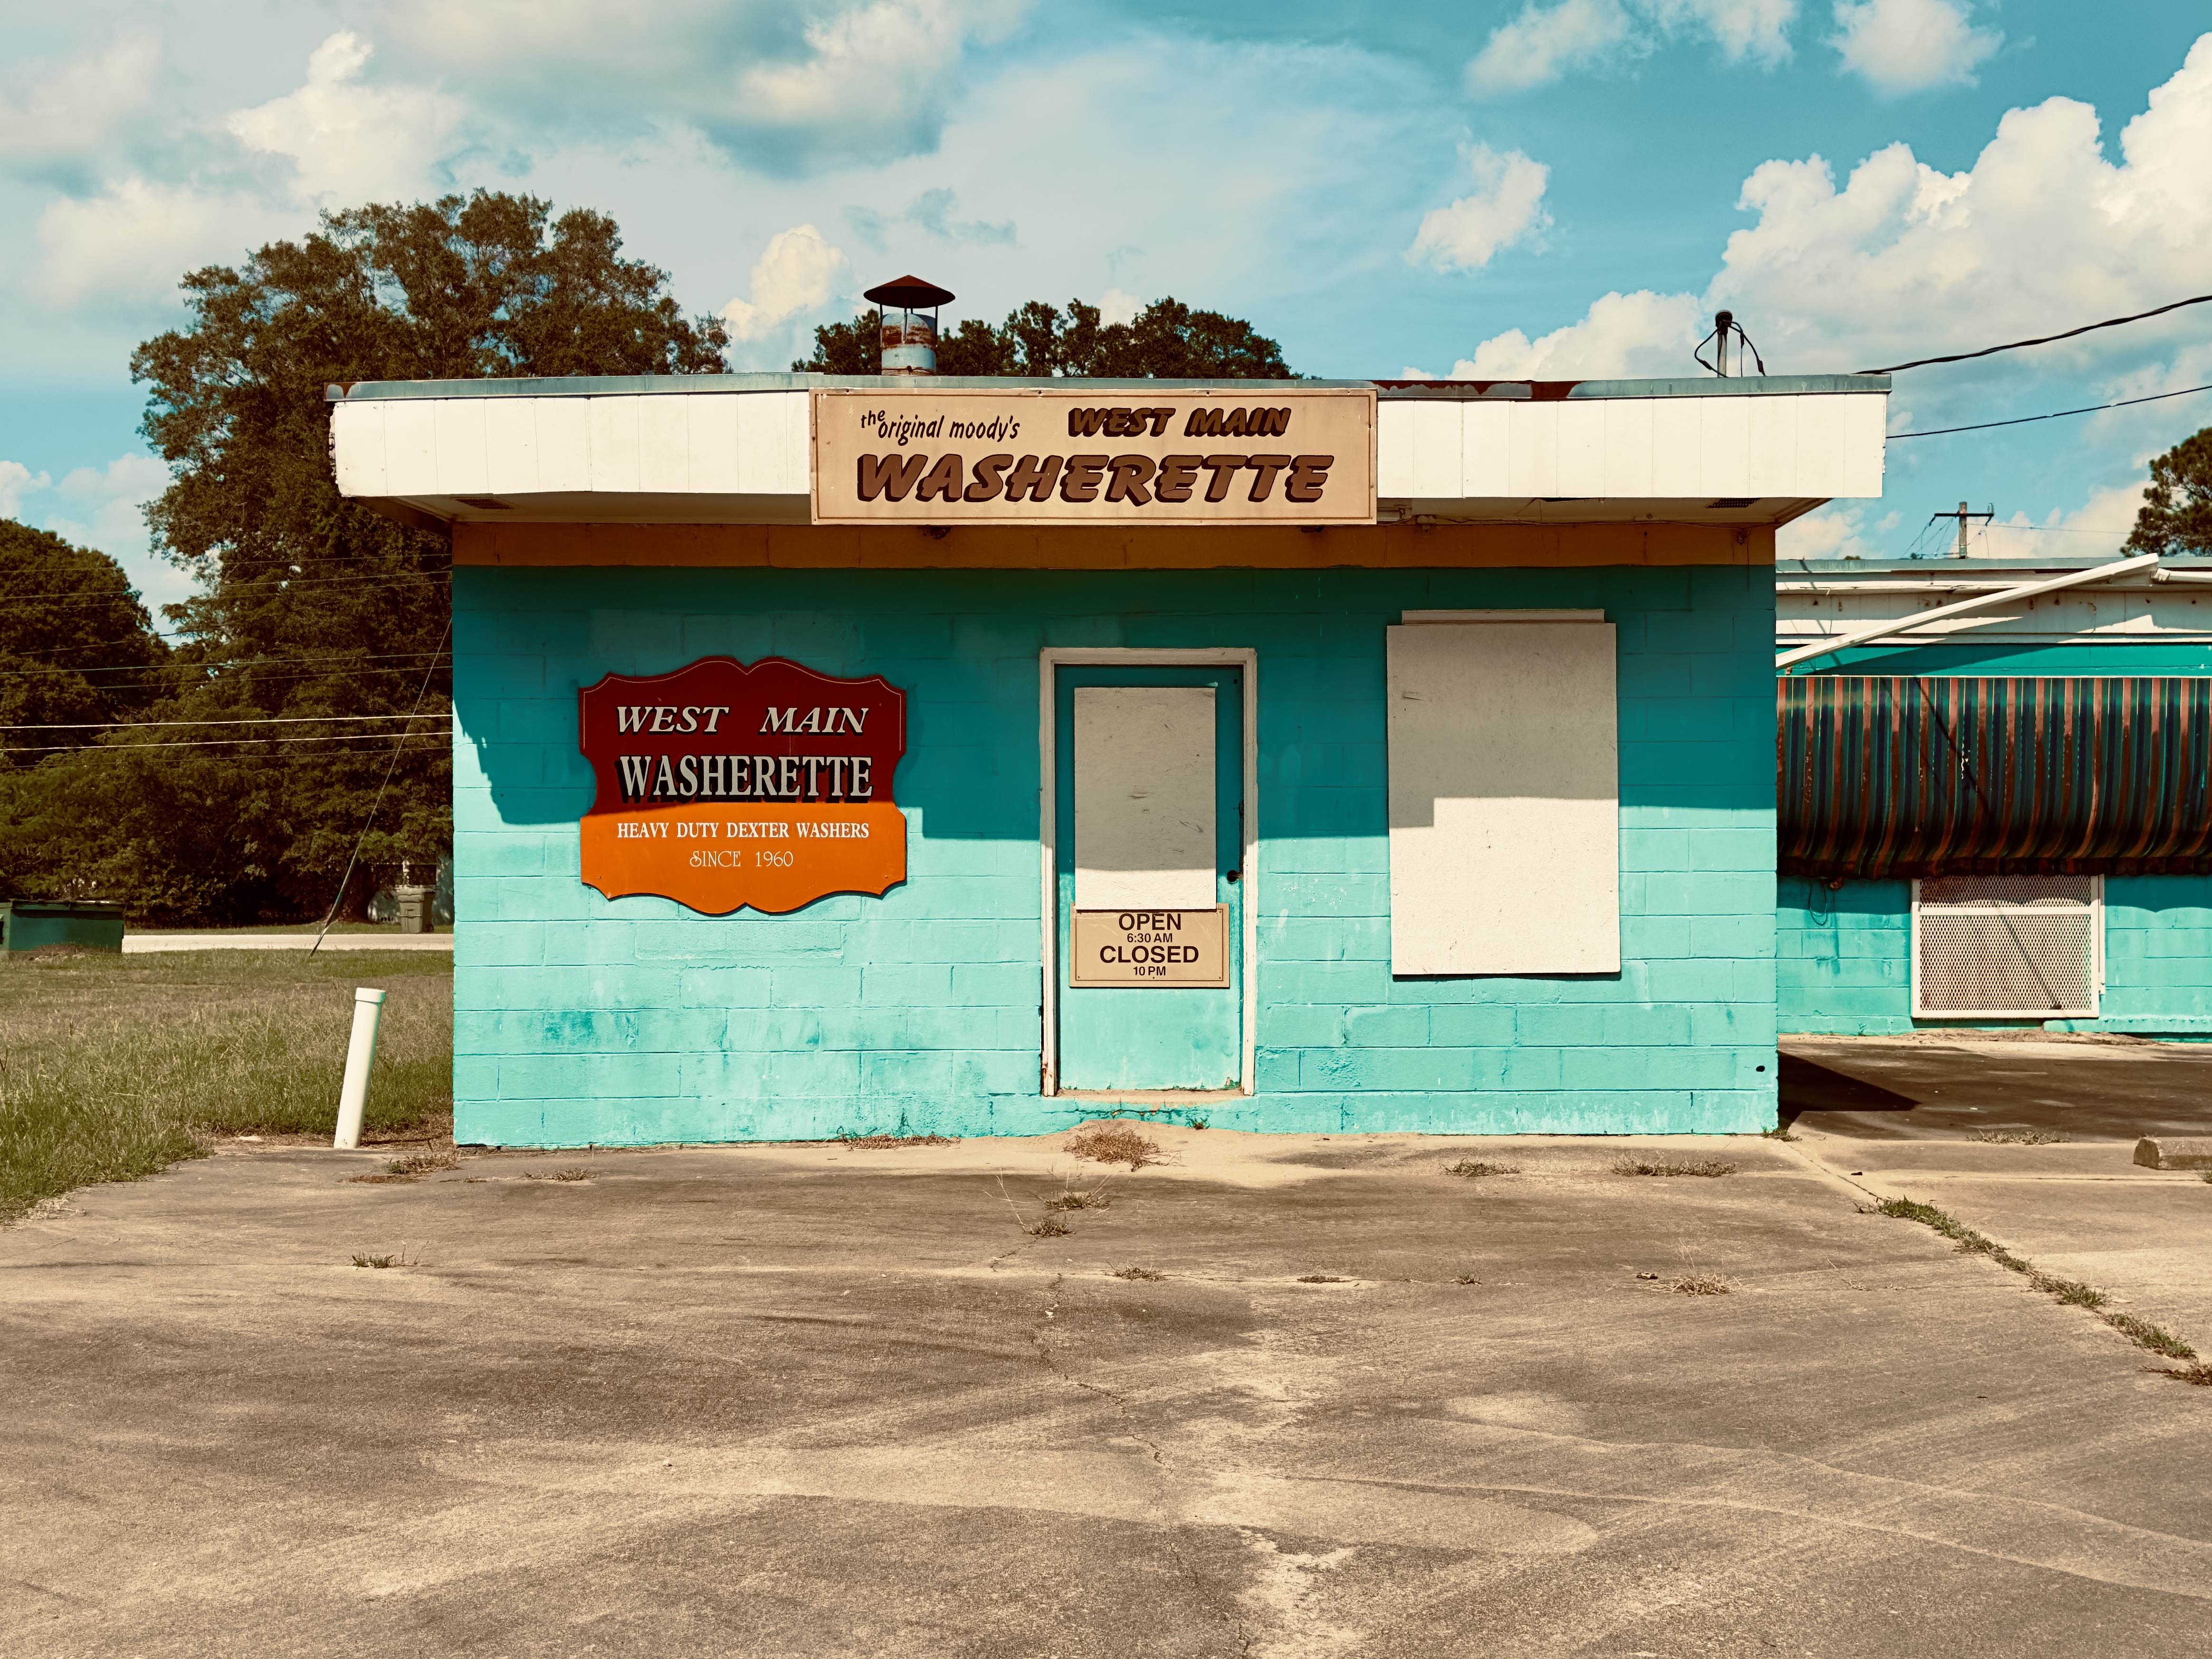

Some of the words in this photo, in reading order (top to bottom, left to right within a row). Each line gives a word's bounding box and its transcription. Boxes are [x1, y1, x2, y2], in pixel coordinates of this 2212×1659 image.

[861, 410, 885, 428] the
[878, 414, 944, 446] original
[949, 415, 1020, 442] moody's
[1068, 408, 1175, 437] WEST
[1183, 408, 1291, 437] MAIN
[857, 454, 1334, 506] WASHERETTE
[617, 706, 729, 733] WEST
[760, 707, 869, 734] MAIN
[620, 755, 873, 796] WASHERETTE
[618, 823, 669, 839] HEAVY
[677, 823, 718, 838] DUTY
[727, 823, 789, 838] DEXTER
[797, 823, 869, 839] WASHERS
[690, 851, 741, 868] SINCE
[755, 851, 794, 868] 1960
[1119, 913, 1181, 930] OPEN
[1127, 933, 1151, 943] 6:30
[1154, 933, 1173, 943] AM
[1100, 945, 1199, 963] CLOSED
[1133, 966, 1145, 976] 10
[1148, 966, 1166, 976] PM
